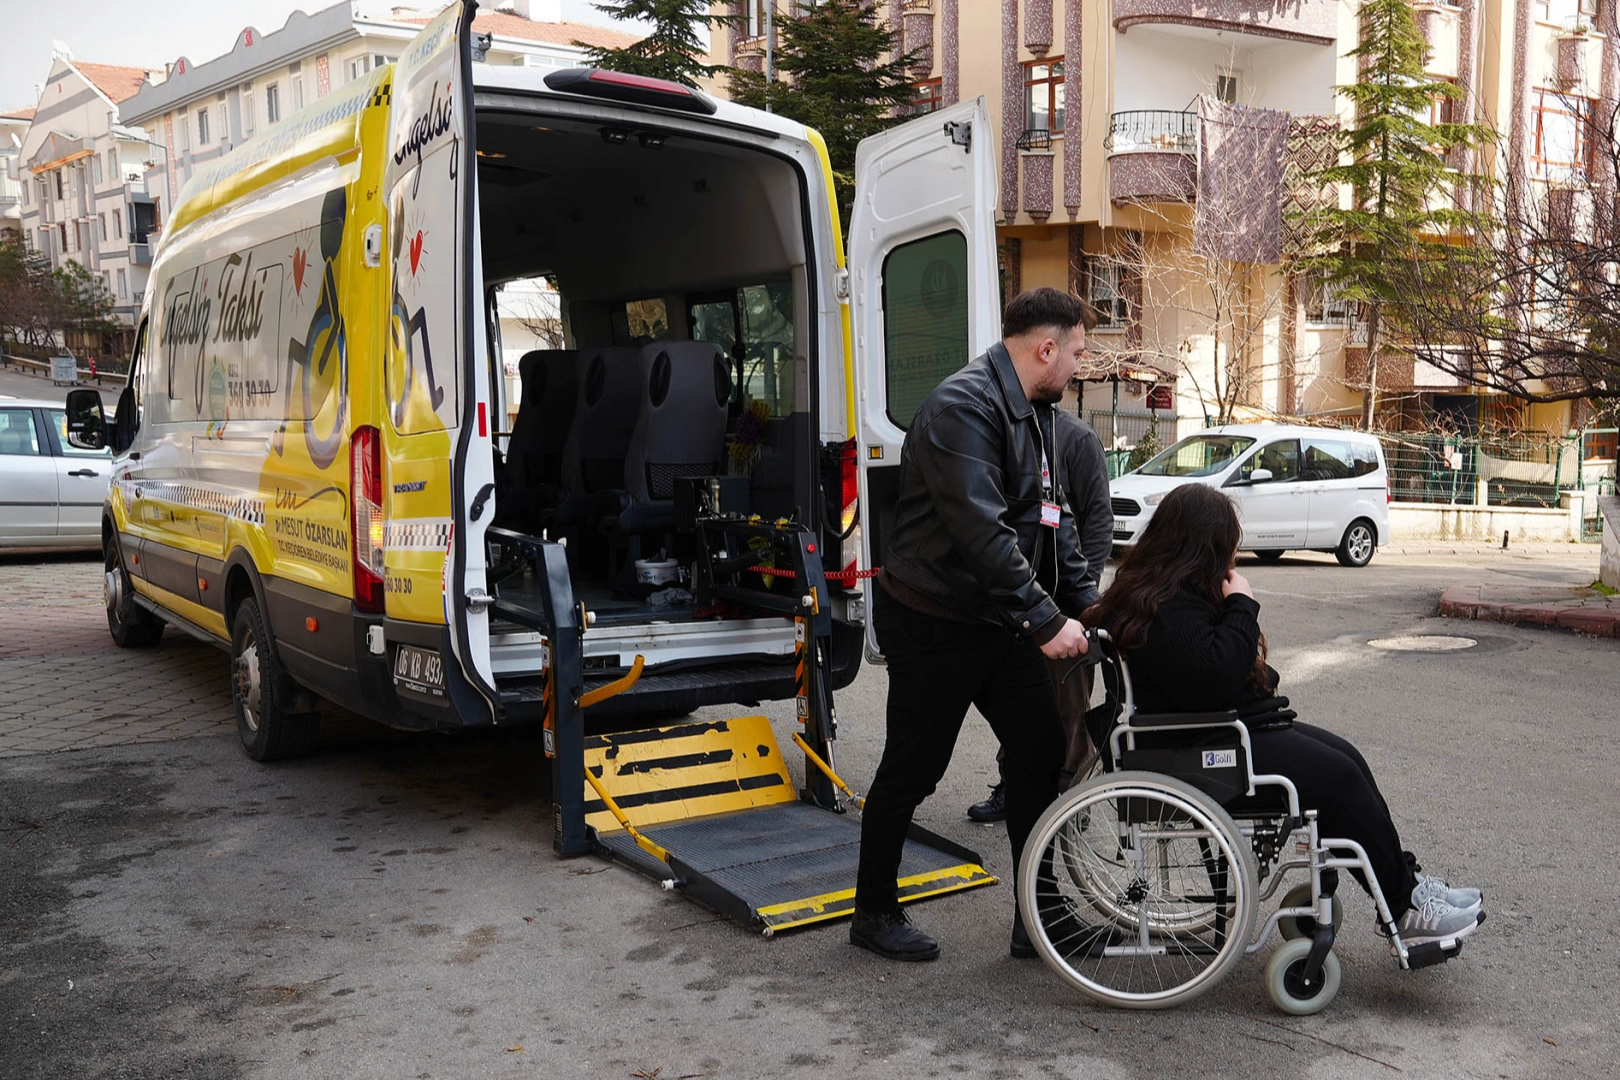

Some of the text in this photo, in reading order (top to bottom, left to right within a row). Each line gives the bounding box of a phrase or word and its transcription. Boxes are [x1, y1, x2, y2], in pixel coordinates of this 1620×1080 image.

[213, 251, 267, 345] Taksi
[228, 379, 271, 407] 360 30 30
[281, 516, 303, 539] MESUT
[305, 517, 348, 552] ÖZARSLAN
[394, 577, 402, 593] 30
[403, 578, 412, 594] 30
[398, 649, 408, 675] 06
[410, 651, 421, 679] KB
